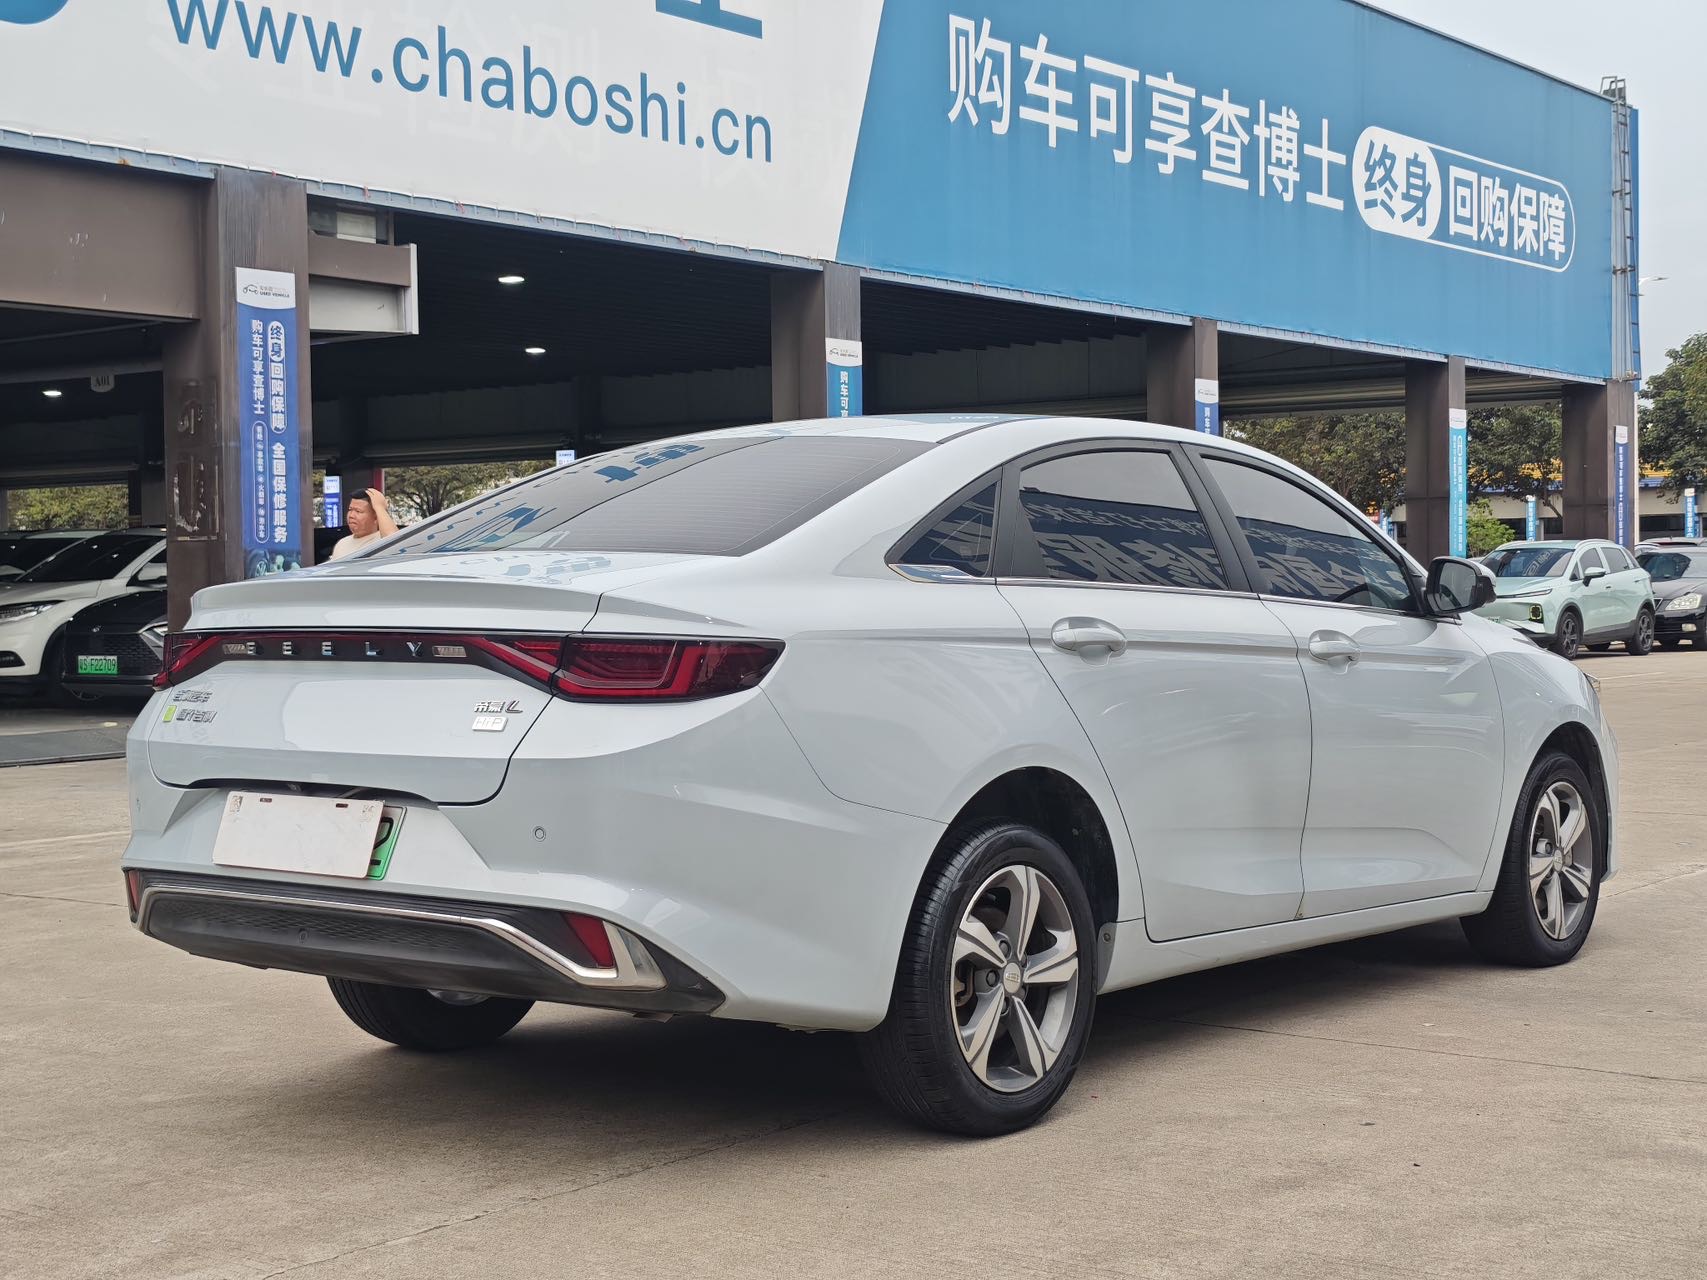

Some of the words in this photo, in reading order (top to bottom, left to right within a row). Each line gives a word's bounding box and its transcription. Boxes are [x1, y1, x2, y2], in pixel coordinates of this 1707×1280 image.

[167, 0, 772, 163] www.chaboshi.cn
[948, 14, 1347, 211] 购车可享查博士
